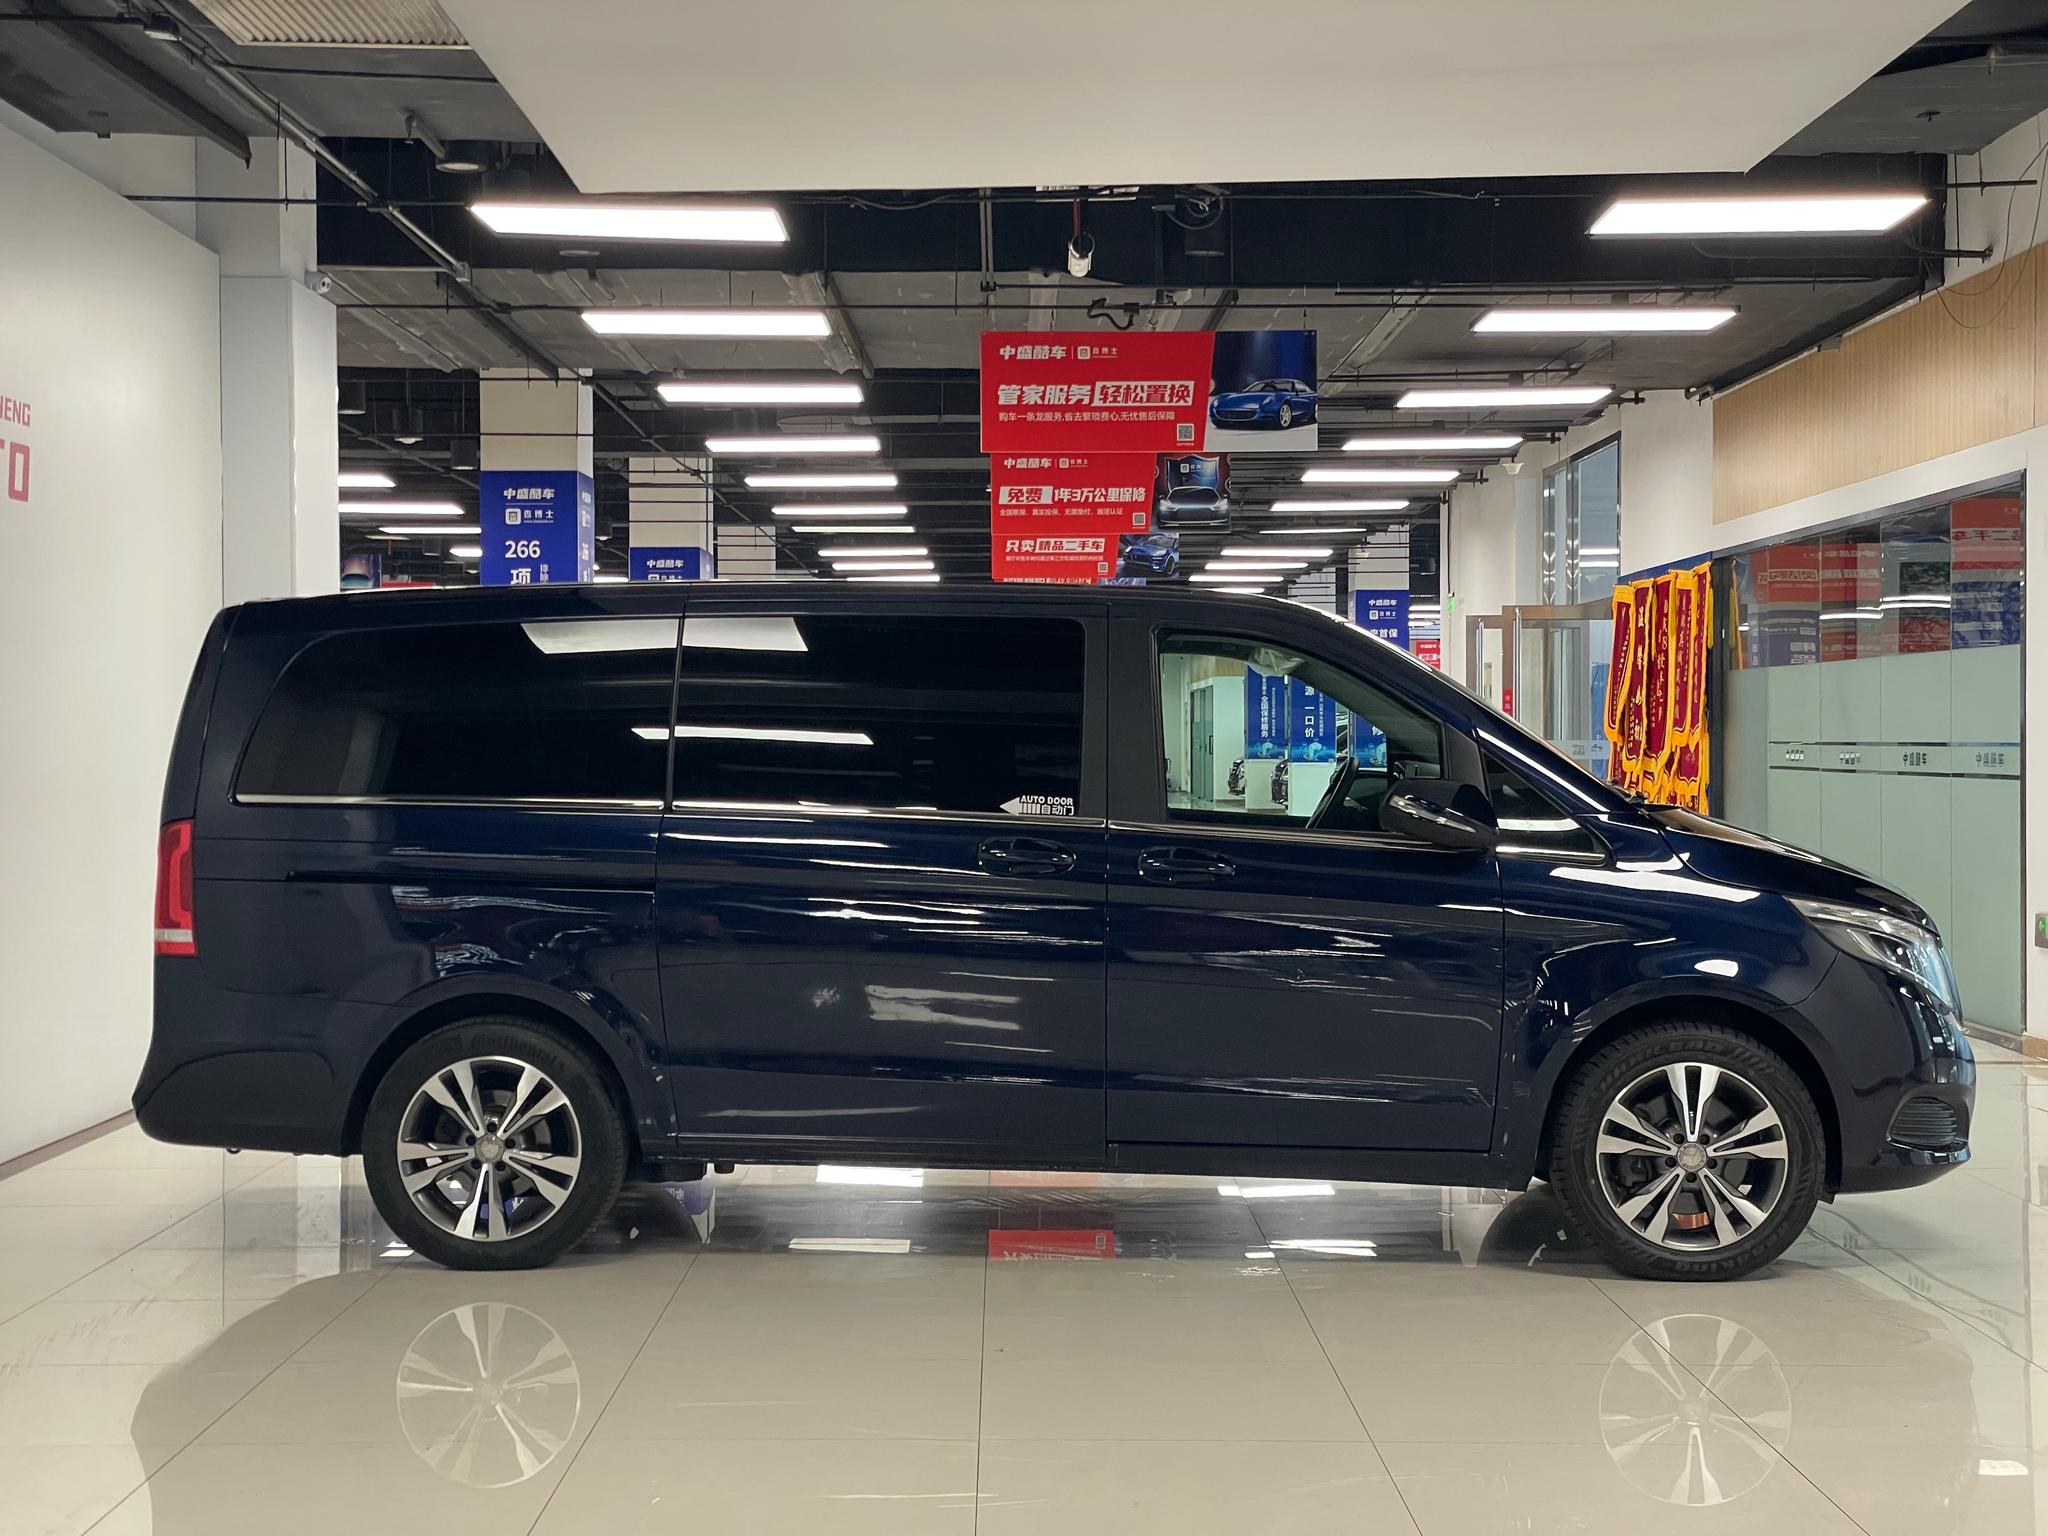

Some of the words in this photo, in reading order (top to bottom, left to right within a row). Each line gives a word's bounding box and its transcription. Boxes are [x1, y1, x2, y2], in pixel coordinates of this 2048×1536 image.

[999, 345, 1067, 360] 中盛酷车
[997, 384, 1092, 406] 管家服务
[1099, 384, 1191, 404] 轻松置换
[1008, 488, 1043, 503] 免费
[1054, 487, 1146, 502] 1年3万公里保修
[505, 540, 540, 558] 266
[1005, 540, 1034, 553] 只卖
[1038, 540, 1104, 551] 精品二手车
[1021, 795, 1045, 804] AUTO
[1047, 797, 1073, 805] DOOR
[1041, 805, 1074, 815] 自动门
